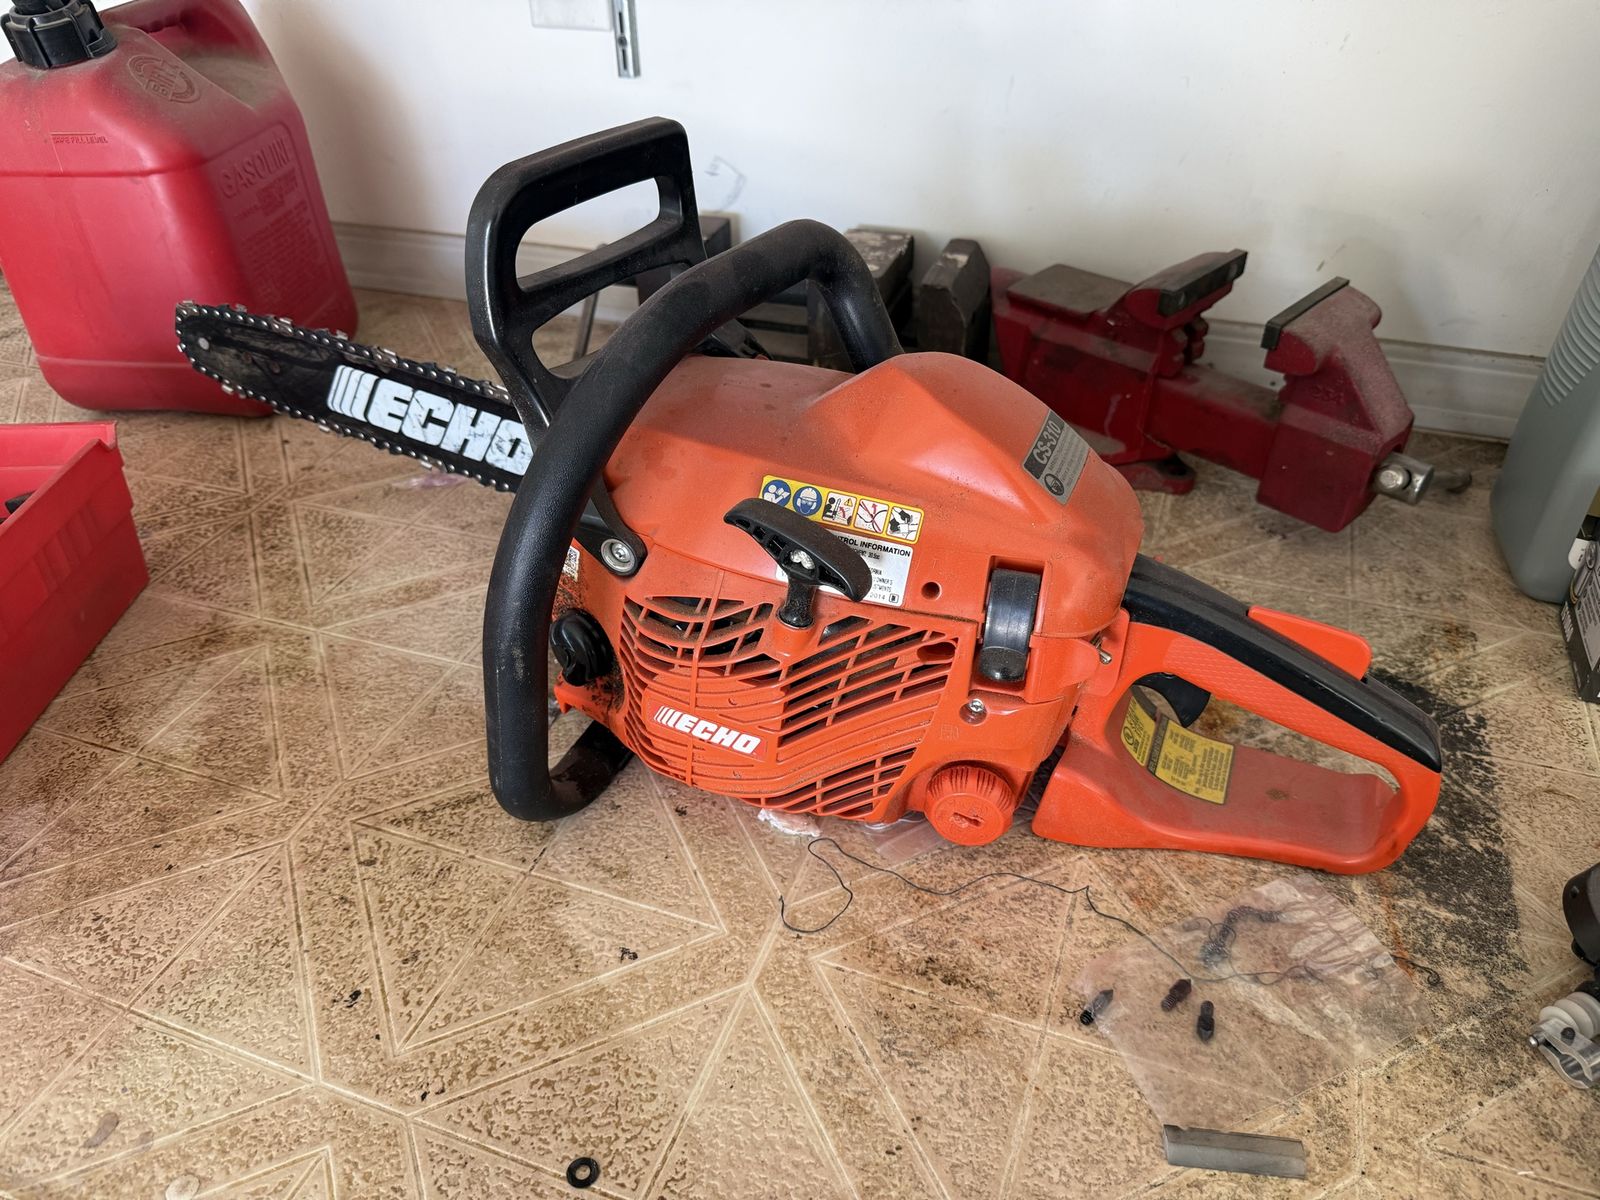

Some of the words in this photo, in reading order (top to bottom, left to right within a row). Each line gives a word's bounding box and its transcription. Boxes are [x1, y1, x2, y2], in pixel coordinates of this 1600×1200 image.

[365, 377, 534, 476] ECHO
[1033, 420, 1062, 465] CS-310
[859, 540, 911, 557] INFORMATION
[674, 713, 761, 755] ECHO
